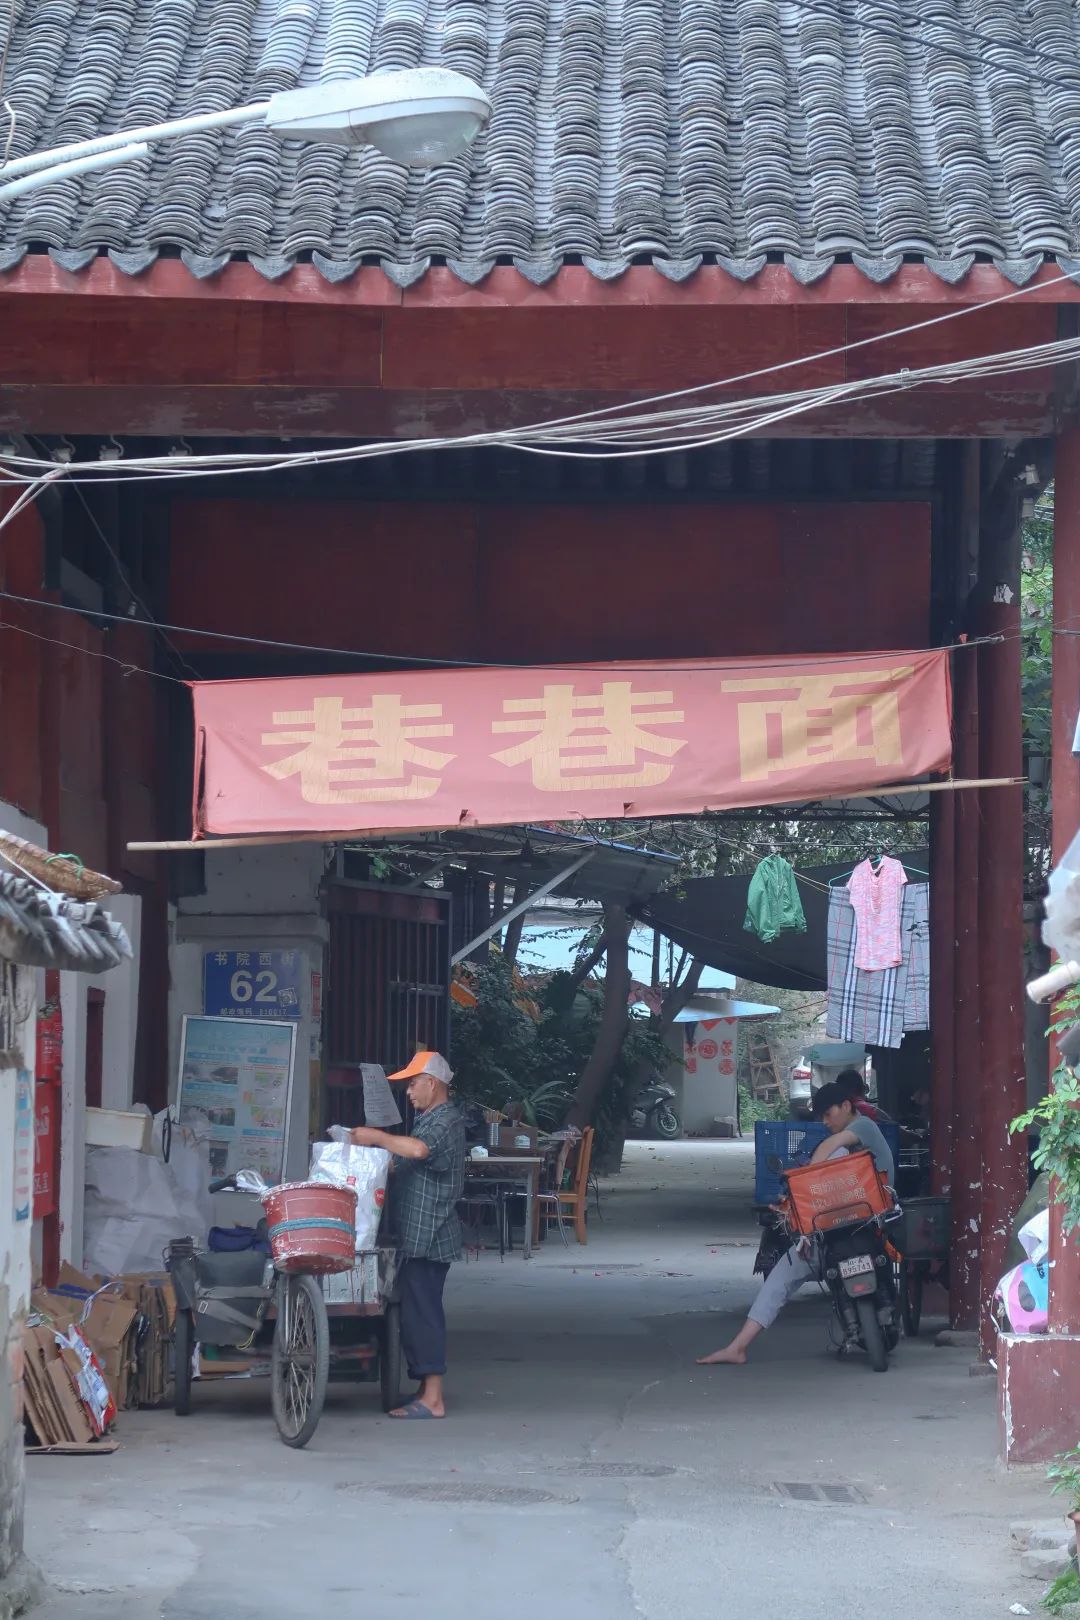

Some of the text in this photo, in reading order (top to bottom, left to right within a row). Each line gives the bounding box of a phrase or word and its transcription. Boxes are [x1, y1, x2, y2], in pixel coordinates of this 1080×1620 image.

[260, 667, 916, 805] 巷巷面
[230, 970, 277, 1002] 62
